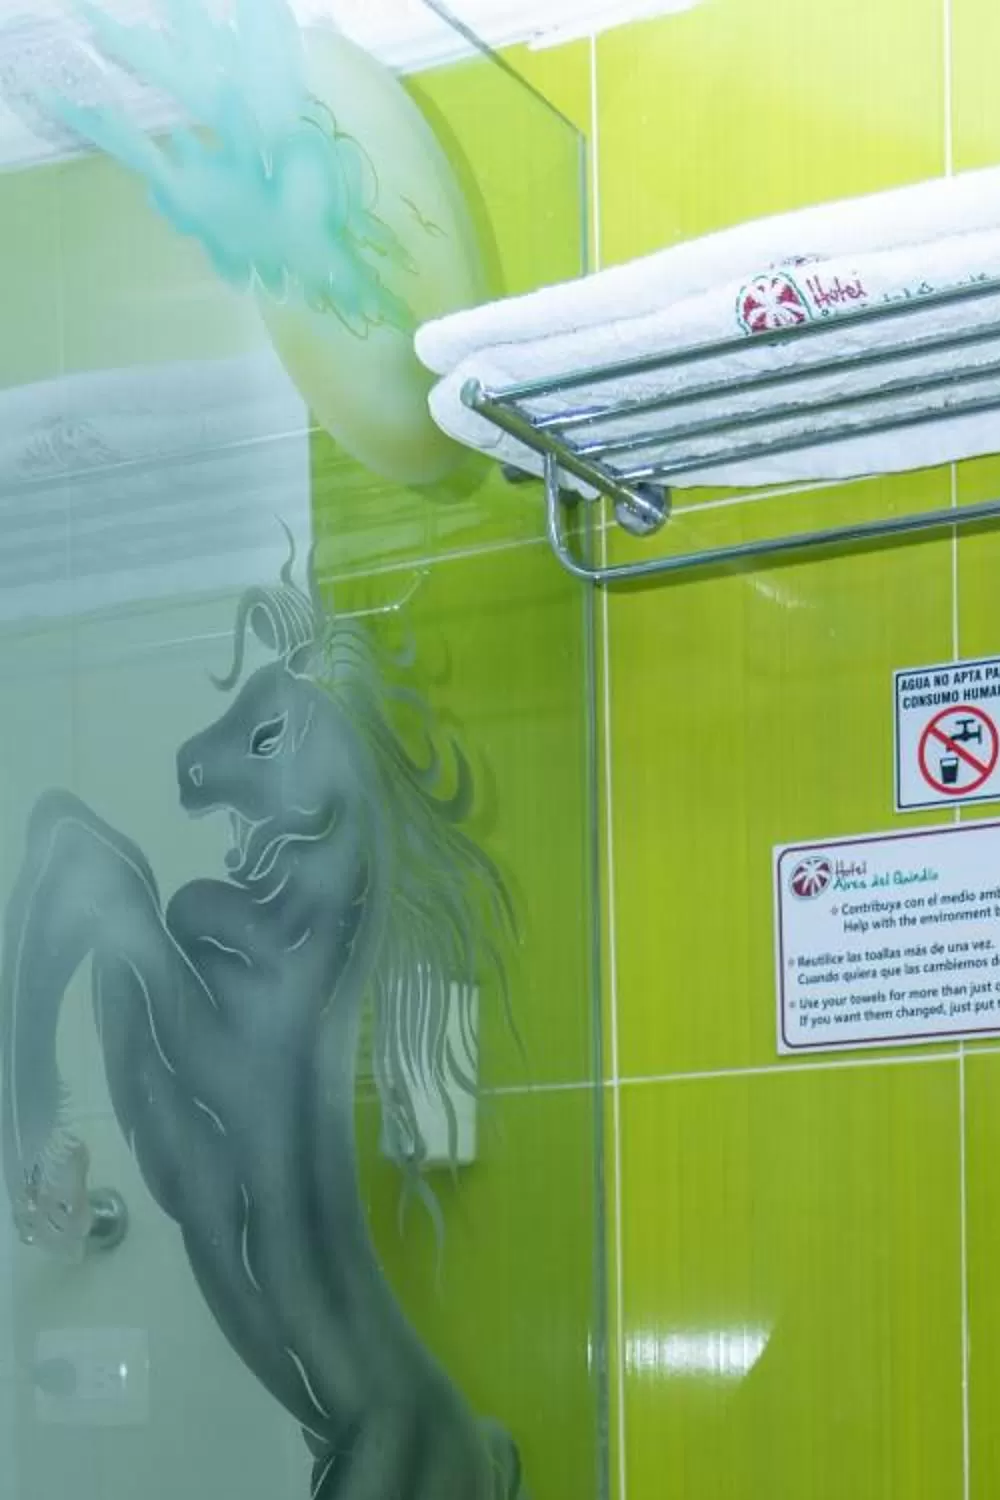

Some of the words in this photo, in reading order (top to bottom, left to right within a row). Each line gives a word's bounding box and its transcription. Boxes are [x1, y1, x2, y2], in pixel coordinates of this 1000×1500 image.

[806, 274, 868, 309] Hotel
[901, 676, 931, 692] AGUA
[934, 674, 949, 687] NO
[953, 668, 982, 684] APTA
[903, 690, 959, 709] CONSUMO
[835, 860, 867, 877] Hotel
[871, 872, 889, 888] del
[842, 899, 901, 916] Contribuya
[904, 897, 925, 908] con
[928, 892, 937, 905] el
[940, 889, 976, 904] medio
[844, 920, 869, 933] Help
[872, 917, 896, 930] with
[899, 913, 917, 926] the
[920, 907, 991, 924] environment
[798, 953, 844, 968] Reutilice
[846, 951, 862, 962] las
[865, 948, 901, 961] toallas
[930, 941, 945, 954] de
[947, 941, 969, 952] una
[972, 939, 996, 951] vez.
[798, 970, 839, 985] Cuando
[842, 967, 877, 982] quiera
[880, 967, 902, 980] que
[904, 963, 920, 974] las
[923, 957, 988, 973] cambiemos
[799, 998, 819, 1009] Use
[821, 996, 847, 1010] your
[850, 992, 886, 1005] towels
[889, 989, 906, 1000] for
[909, 988, 938, 999] more
[941, 983, 967, 996] than
[970, 981, 991, 997] just
[800, 1015, 810, 1027] If
[811, 1015, 831, 1028] you
[834, 1012, 861, 1024] want
[864, 1009, 893, 1021] them
[950, 1000, 971, 1017] just
[974, 1000, 995, 1014] put
